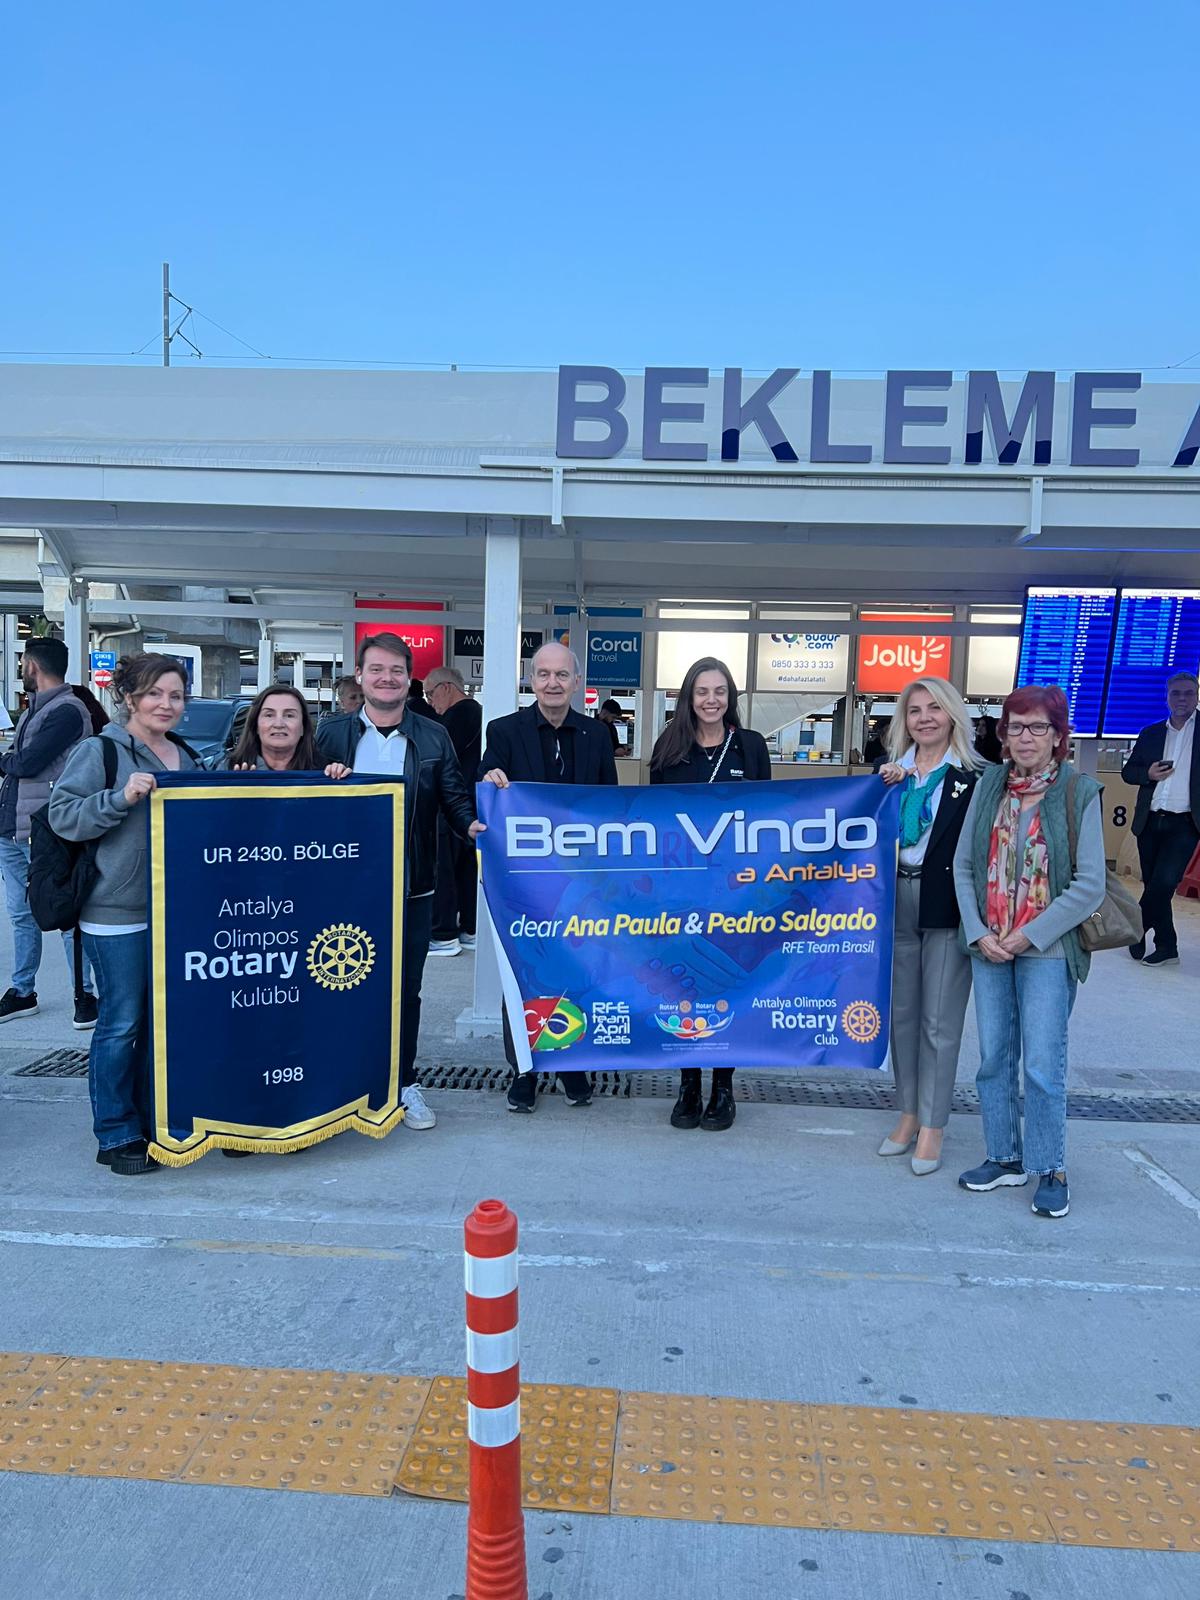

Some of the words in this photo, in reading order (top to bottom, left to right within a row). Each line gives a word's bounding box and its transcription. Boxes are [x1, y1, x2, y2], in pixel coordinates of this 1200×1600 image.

[557, 364, 1143, 466] BEKLEME
[401, 634, 434, 649] tur
[590, 637, 638, 652] Coral
[804, 642, 833, 650] .com
[591, 653, 617, 662] travel
[771, 660, 792, 668] 0850
[793, 660, 809, 669] 333
[811, 661, 816, 669] 3
[818, 661, 834, 669] 333
[863, 644, 927, 673] Jolly
[1112, 805, 1127, 827] 8
[505, 816, 657, 857] Bem
[675, 808, 878, 855] Vindo
[203, 847, 232, 864] UR
[237, 846, 287, 862] 2430.
[293, 841, 360, 861] BÖLGE
[736, 867, 756, 883] a
[764, 861, 877, 883] Antalya
[218, 896, 294, 919] Antalya
[509, 914, 562, 938] dear
[562, 914, 610, 938] Ana
[613, 911, 681, 936] Paula
[684, 912, 704, 934] &
[707, 910, 776, 934] Pedro
[779, 907, 877, 937] Salgado
[213, 929, 299, 950] Olimpos
[327, 930, 356, 940] ROTARY
[781, 941, 804, 954] RFE
[806, 941, 840, 954] Team
[841, 940, 875, 954] Brasil
[184, 950, 299, 981] Rotary
[317, 965, 366, 984] INTERNATIONAL
[230, 985, 300, 1009] Kulübü
[752, 997, 791, 1010] Antalya
[794, 997, 837, 1010] Olimpos
[592, 1001, 630, 1014] RFE
[659, 1003, 679, 1011] Rotary
[695, 1002, 716, 1010] Rotary
[592, 1013, 630, 1024] team
[771, 1010, 837, 1032] Rotary
[593, 1022, 630, 1036] April
[593, 1035, 631, 1045] 2026
[814, 1034, 839, 1046] Club
[262, 1066, 304, 1086] 1998
